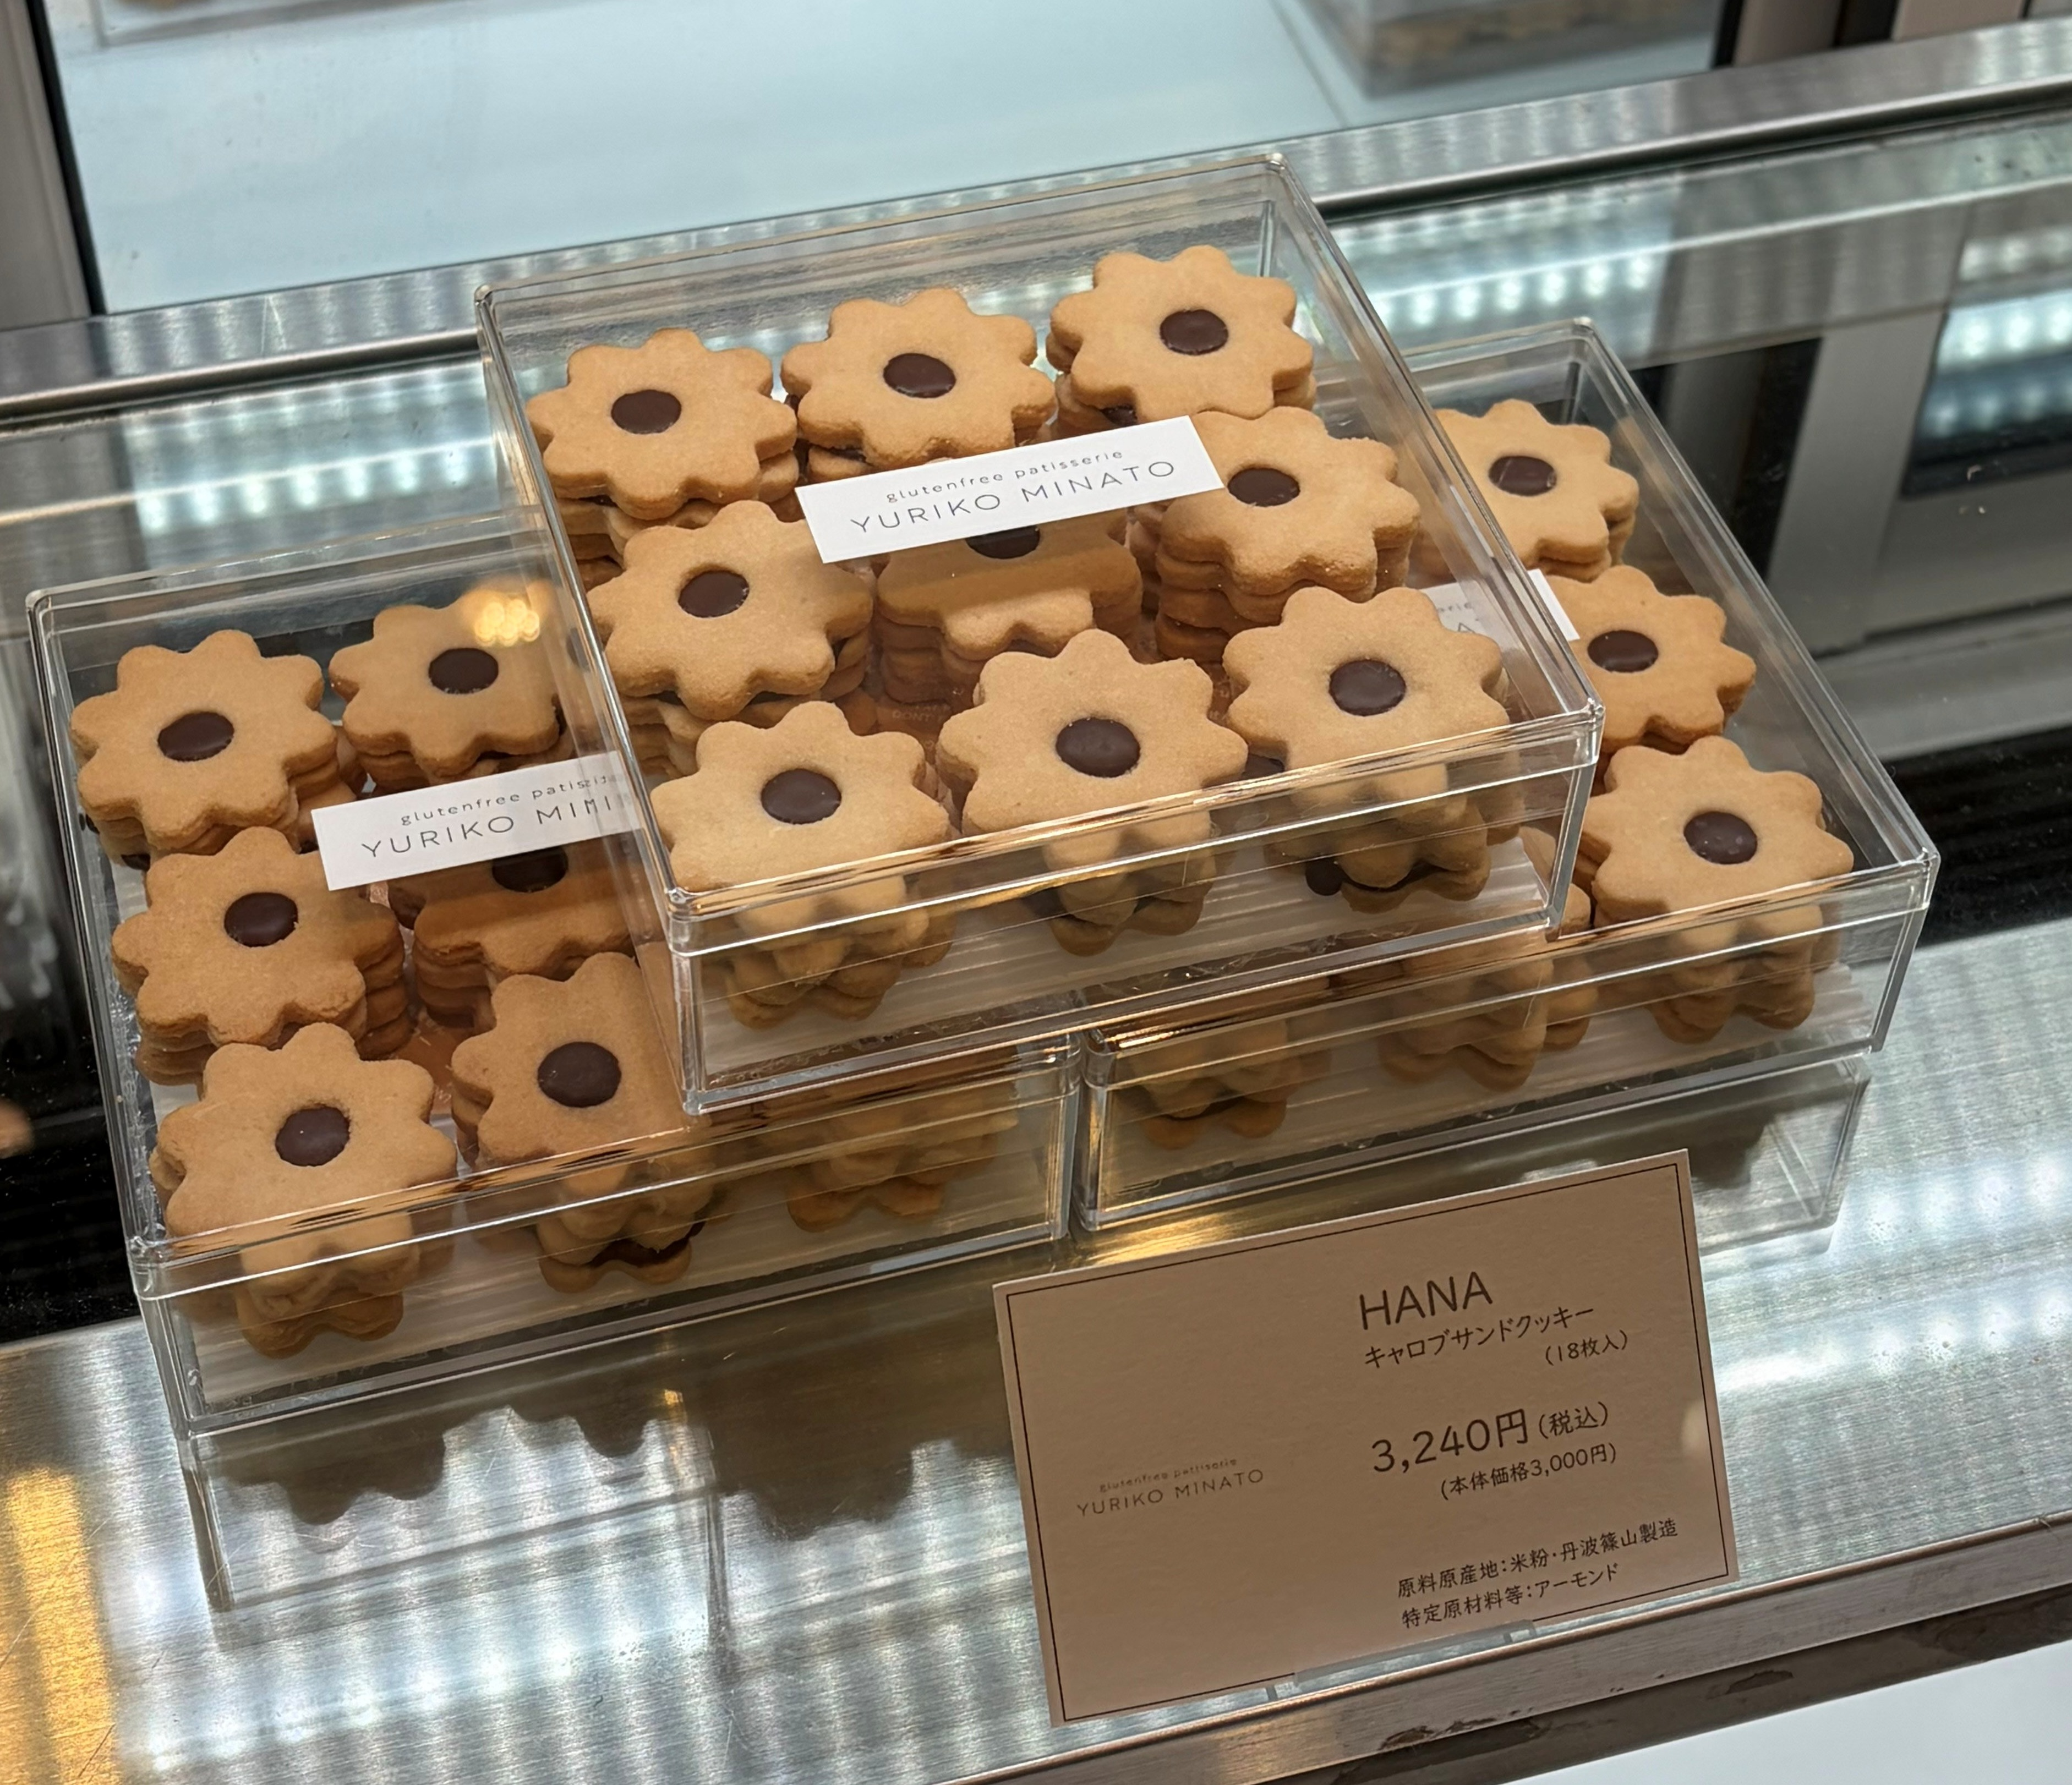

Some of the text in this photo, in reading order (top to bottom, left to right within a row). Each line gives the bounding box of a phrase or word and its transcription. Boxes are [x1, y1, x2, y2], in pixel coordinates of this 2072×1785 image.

[850, 461, 1174, 534] YURIKO MINATO
[886, 450, 1123, 503] glutenfree patisserie
[401, 793, 520, 825] glutenfree
[362, 816, 514, 858] YURIKO
[1359, 1272, 1493, 1330] HANA
[1365, 1307, 1594, 1368] キャロブサンドクッキー
[1545, 1329, 1628, 1366] (18枚入)
[1077, 1469, 1264, 1516] YURIKO MINATO
[1441, 1443, 1616, 1501] (本体価格3,000円)
[1402, 1563, 1618, 1629] 特定原材料等:アーモンド
